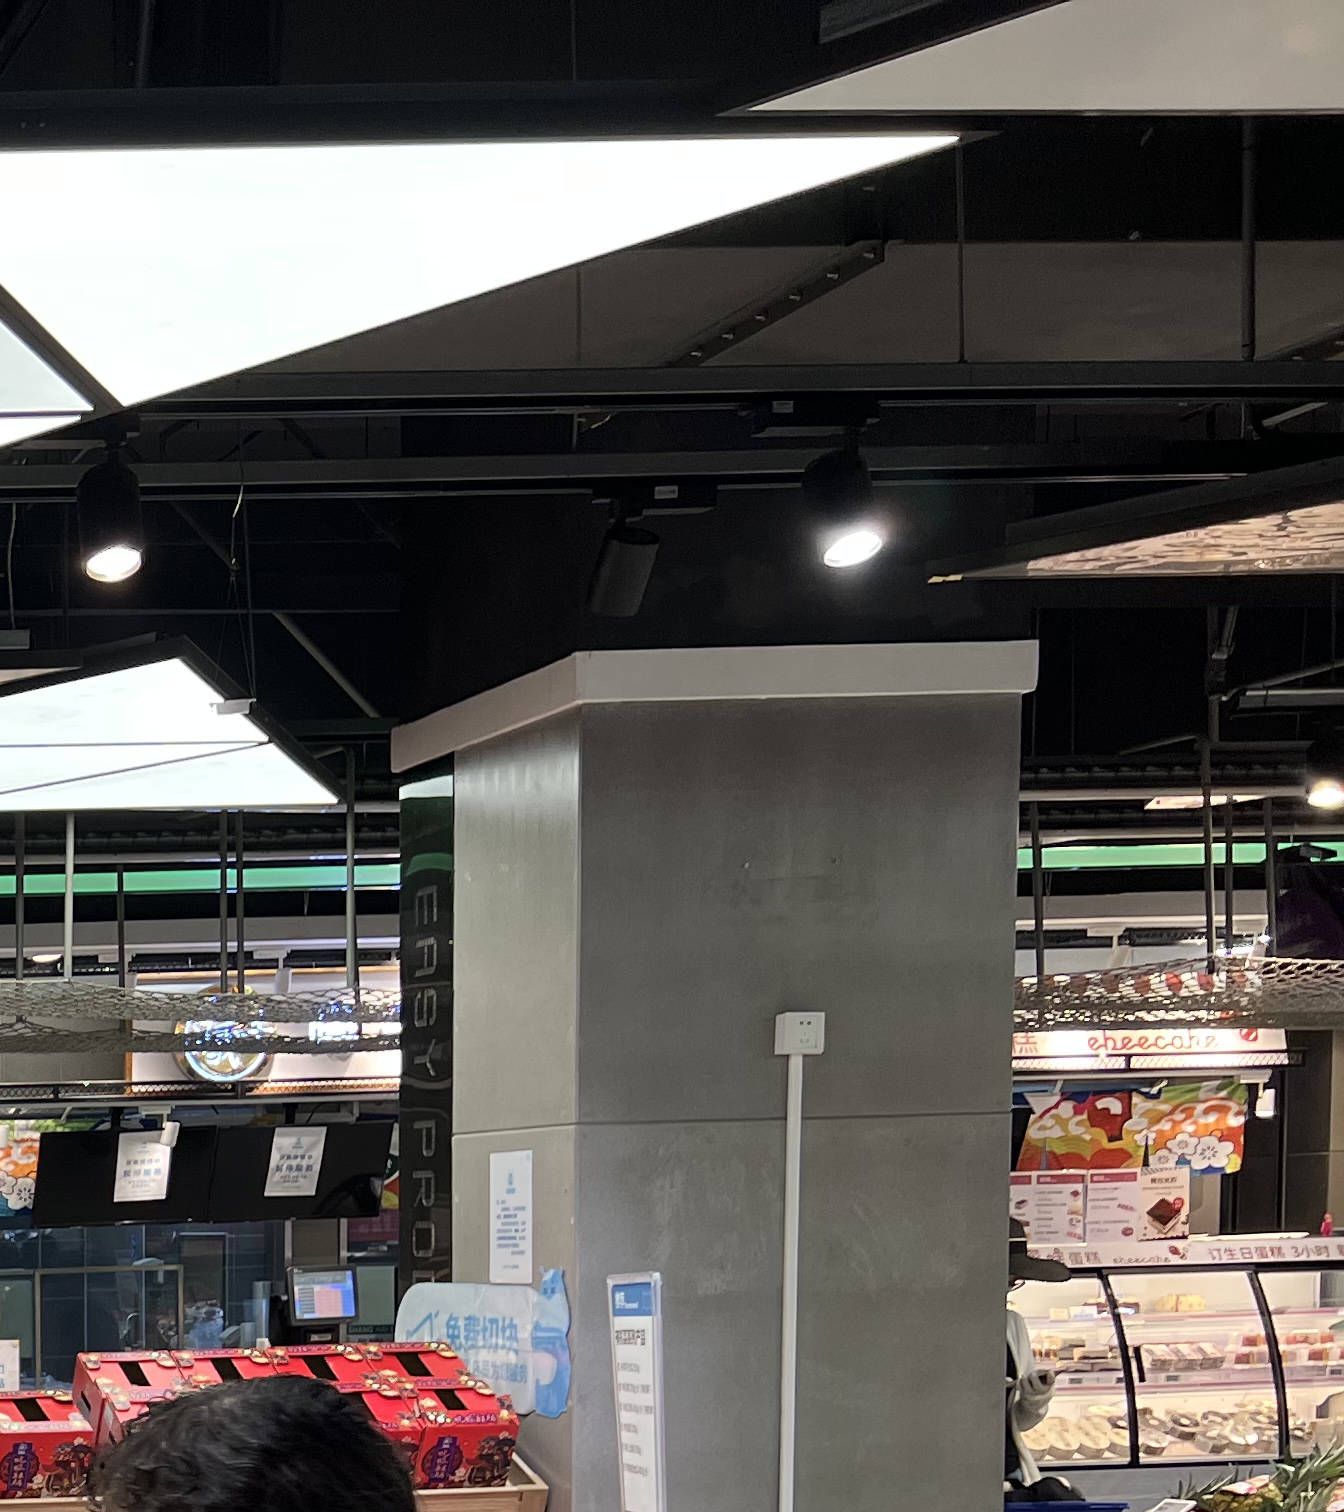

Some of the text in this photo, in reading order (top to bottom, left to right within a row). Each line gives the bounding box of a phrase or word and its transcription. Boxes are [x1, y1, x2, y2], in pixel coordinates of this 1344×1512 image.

[414, 885, 438, 1077] EASY
[444, 1313, 519, 1352] 免费切块
